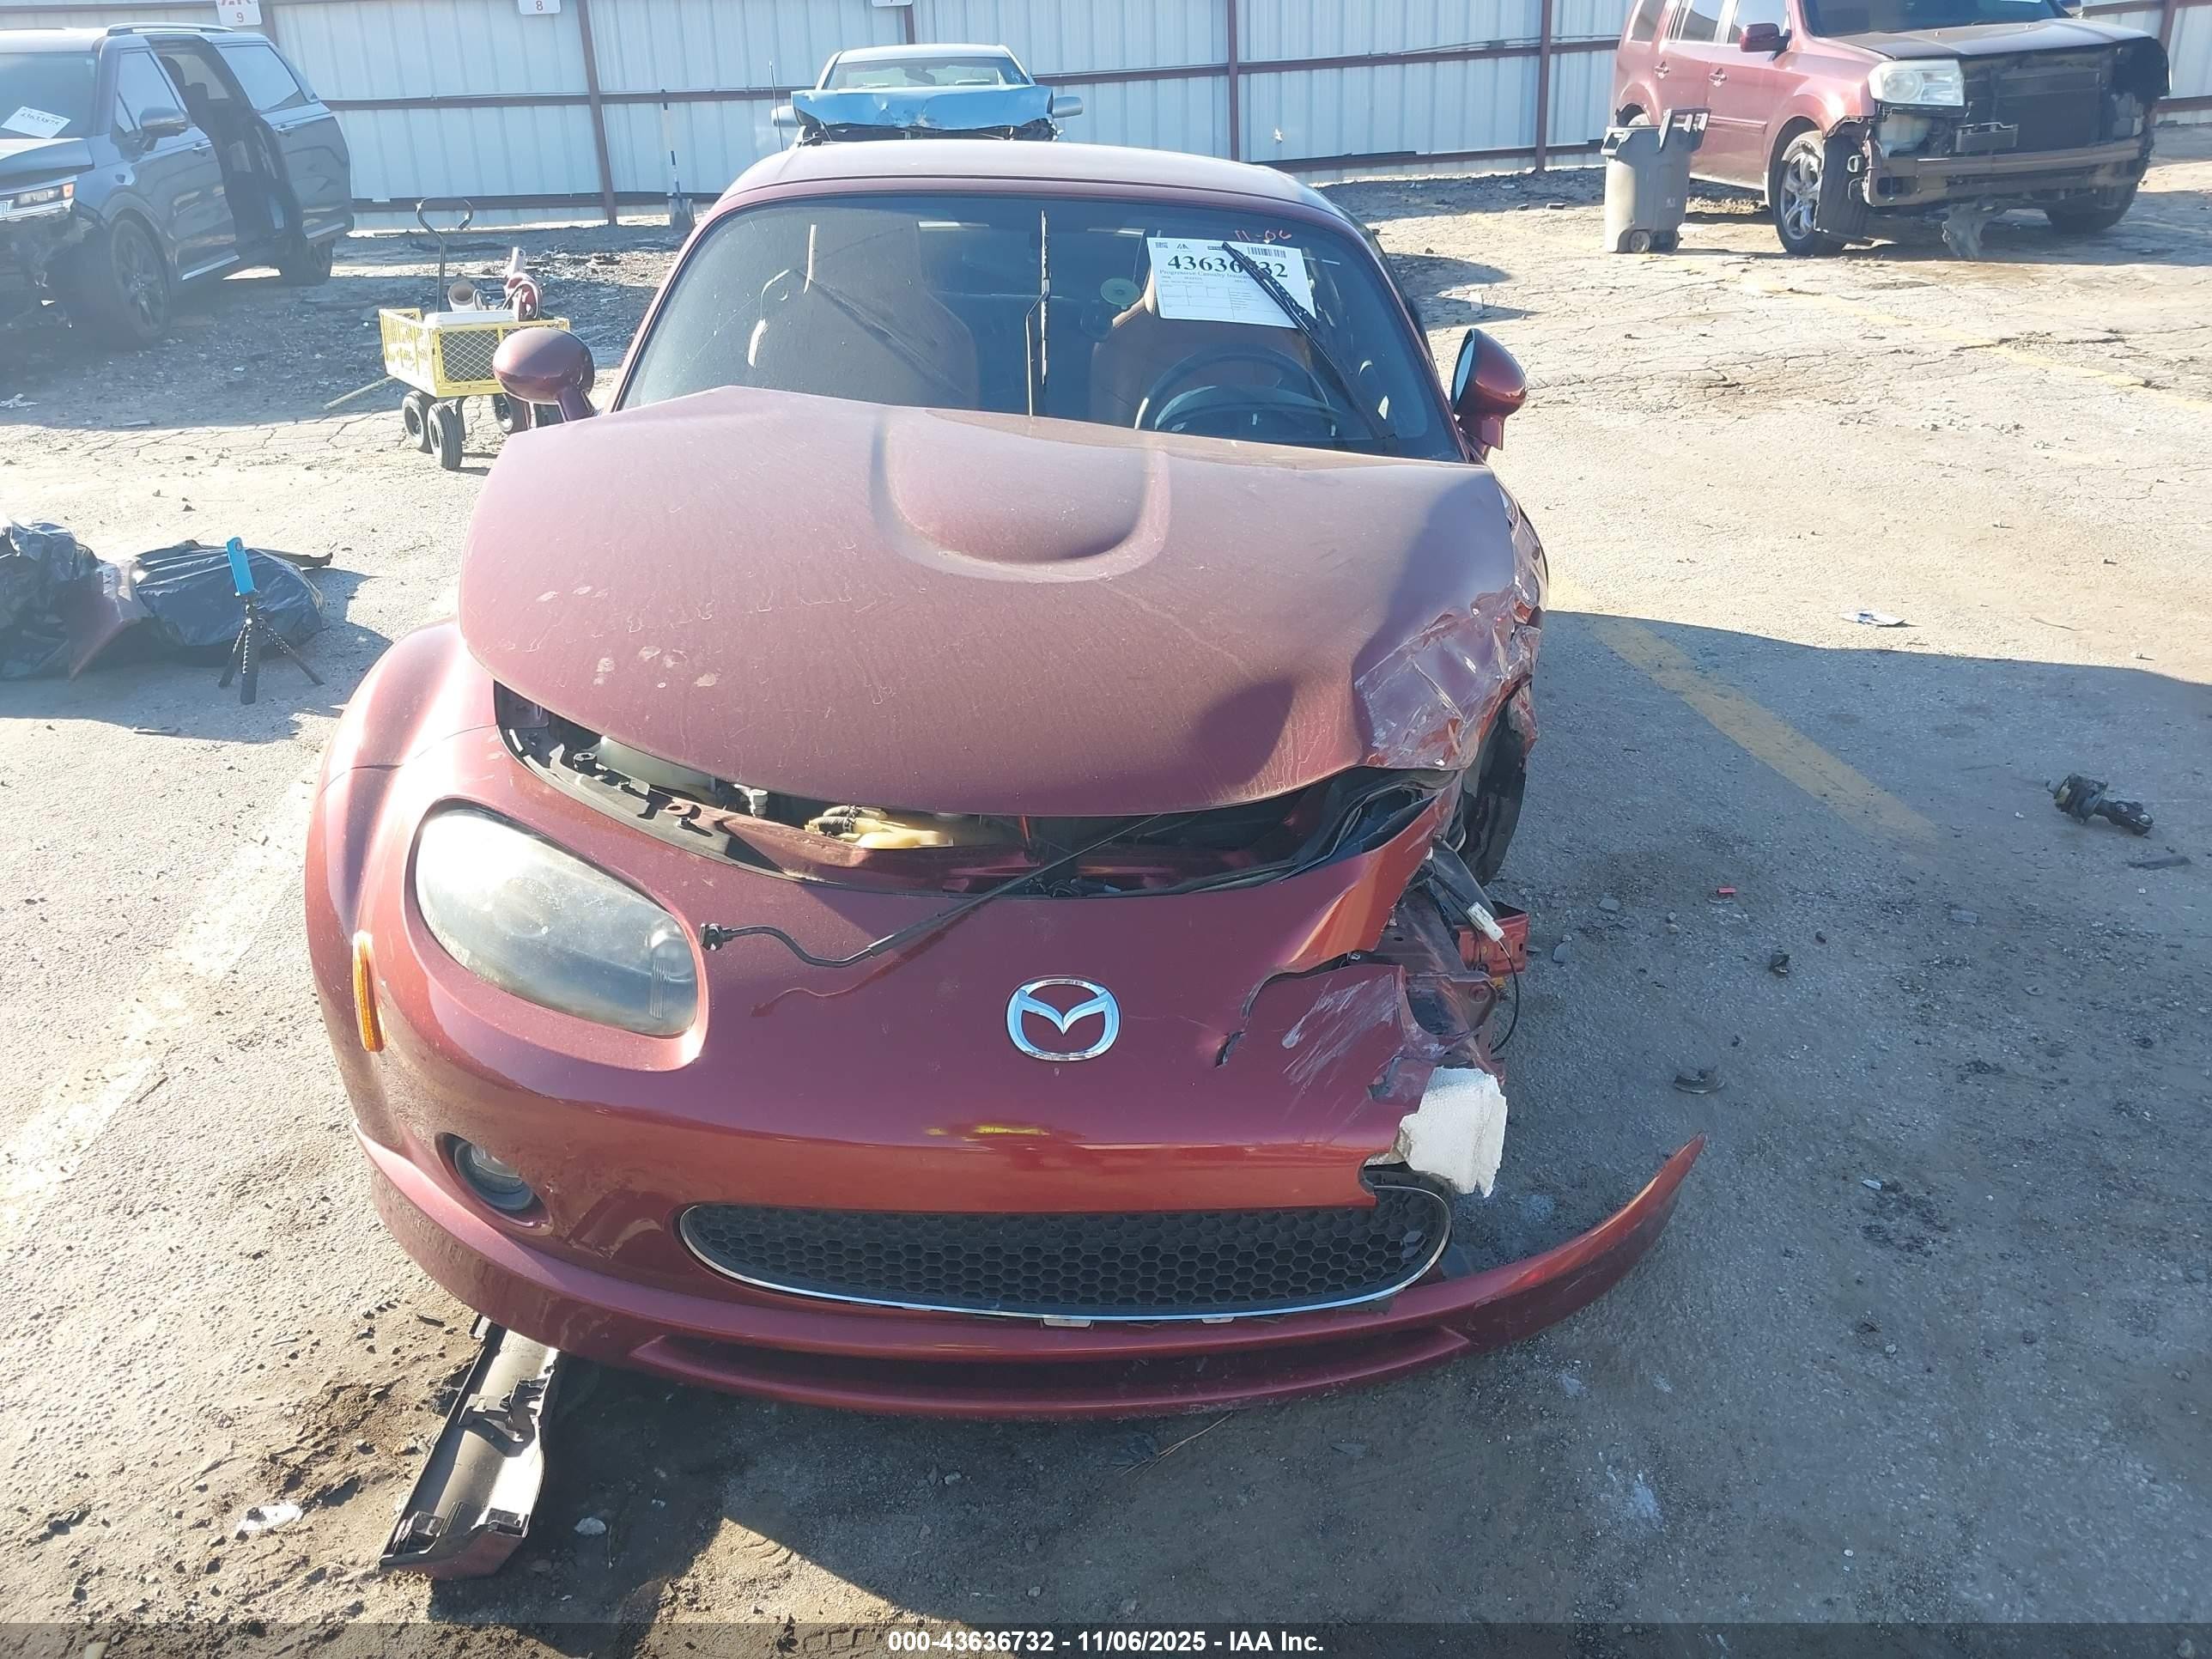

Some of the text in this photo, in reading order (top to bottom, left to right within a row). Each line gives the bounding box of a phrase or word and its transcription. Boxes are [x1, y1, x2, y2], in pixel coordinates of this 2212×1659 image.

[536, 0, 544, 11] 8
[236, 12, 244, 22] 9
[1167, 255, 1288, 278] 4363632
